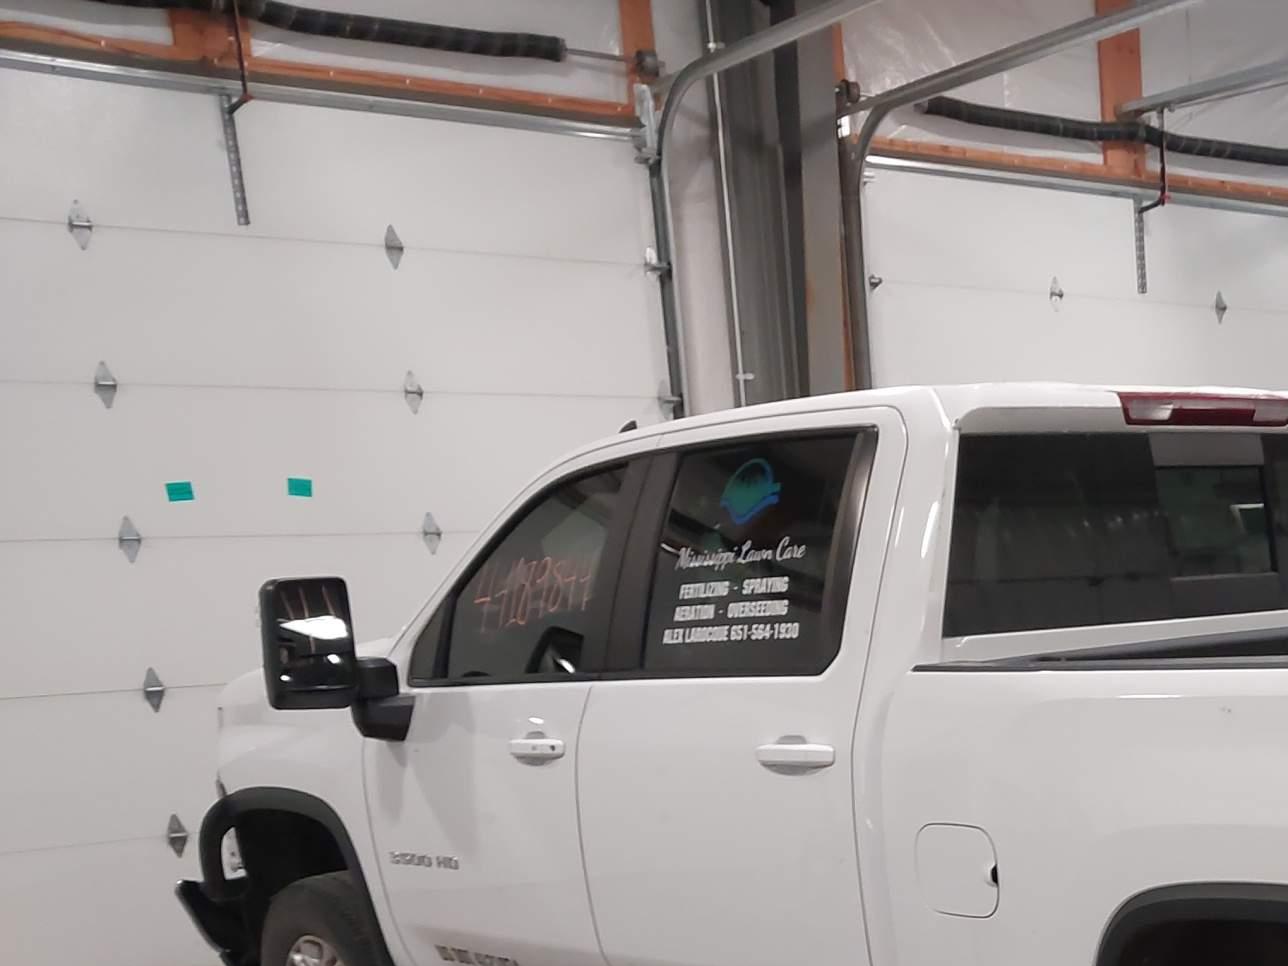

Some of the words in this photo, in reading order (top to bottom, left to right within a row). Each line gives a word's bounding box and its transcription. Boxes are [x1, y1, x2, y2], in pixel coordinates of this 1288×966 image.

[675, 546, 736, 571] Mississippi
[737, 540, 773, 564] Lawn
[775, 536, 807, 562] Care
[679, 581, 731, 600] FERTILIZING
[741, 576, 790, 595] SPRAYING
[673, 604, 716, 622] AERATION
[727, 599, 790, 619] OVERSEEDING
[662, 628, 684, 645] ALEX
[436, 855, 460, 870] HD
